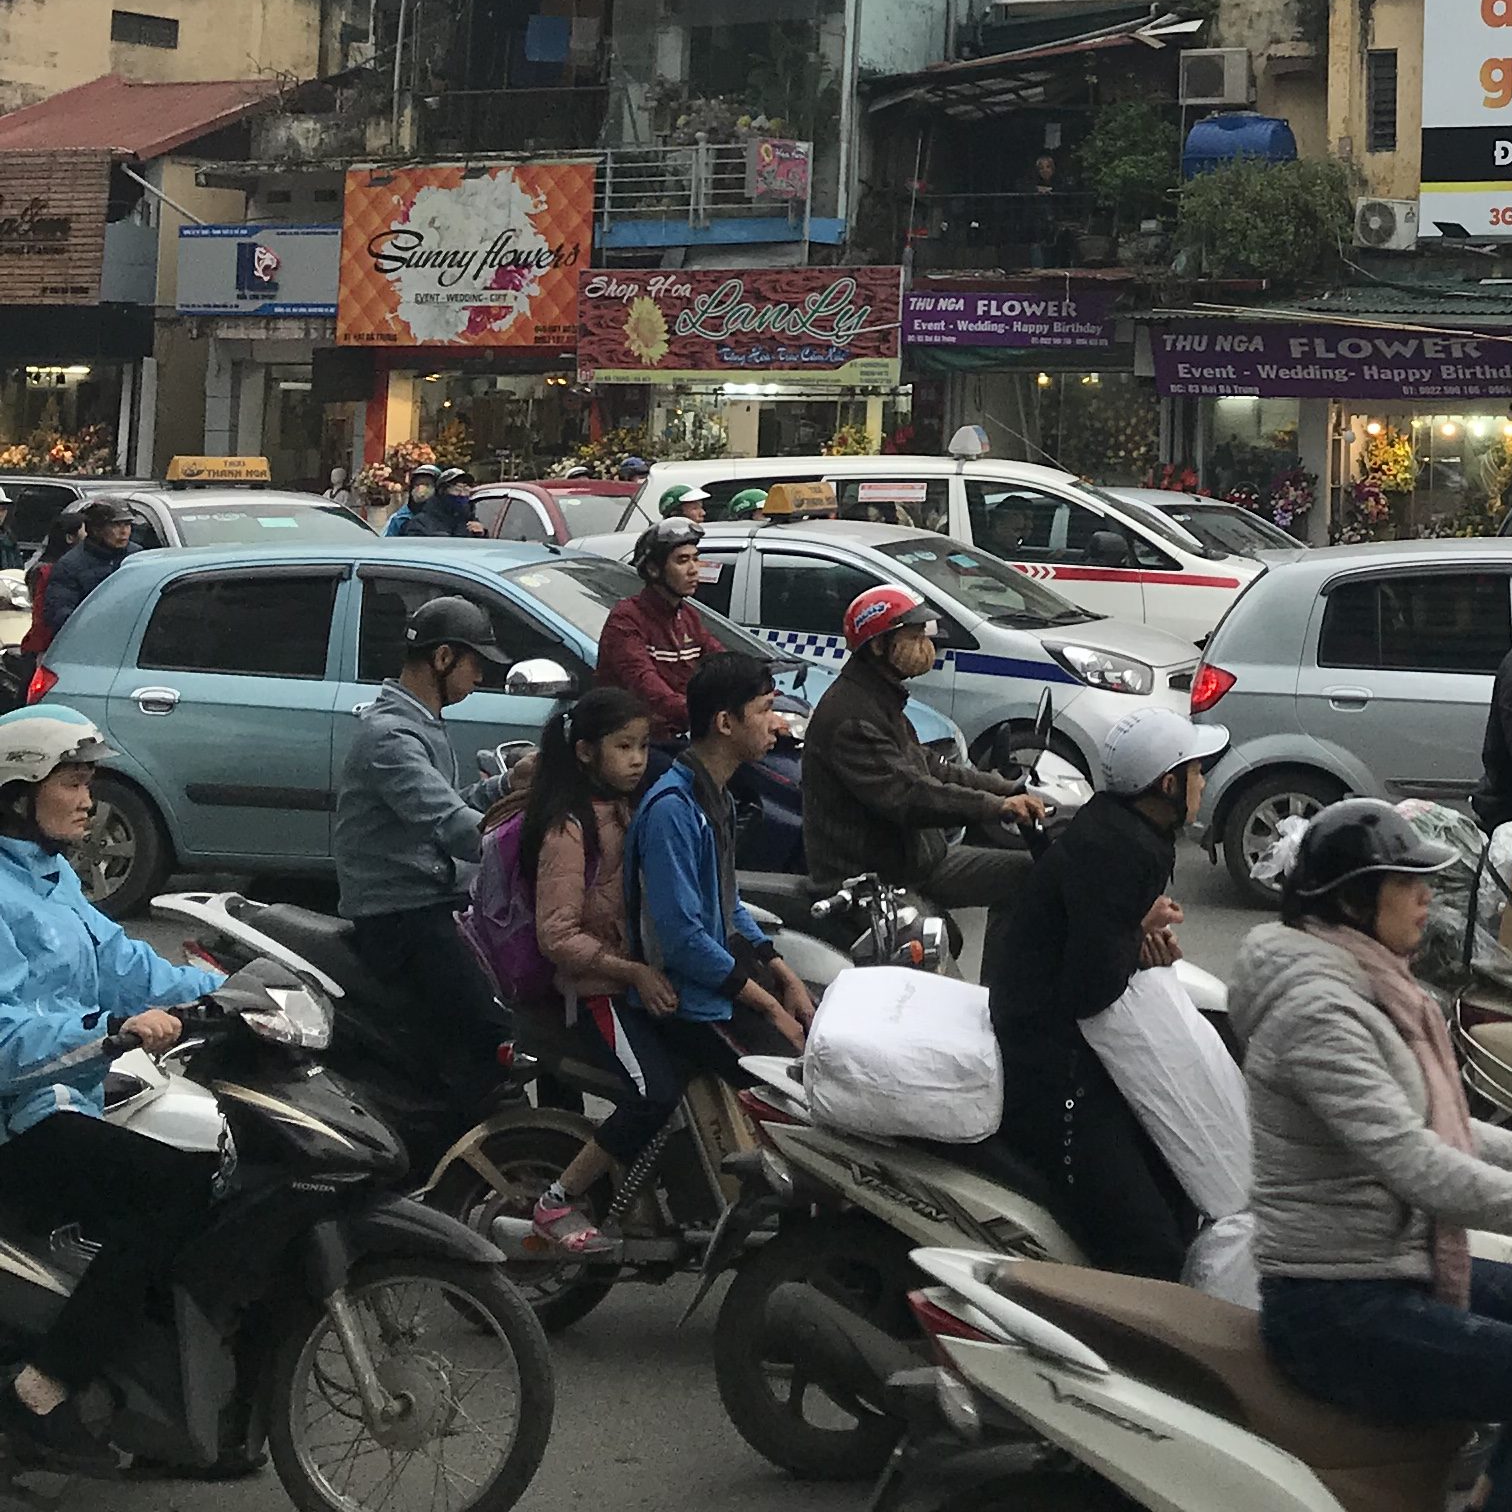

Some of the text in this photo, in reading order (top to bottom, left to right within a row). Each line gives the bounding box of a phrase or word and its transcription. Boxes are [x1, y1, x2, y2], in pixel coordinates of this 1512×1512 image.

[367, 229, 482, 287] Sunny
[414, 292, 441, 304] EVENT
[584, 275, 692, 303] Shop Hoa
[909, 298, 1078, 318] THU NGA FLOWER
[913, 319, 946, 332] Event
[1013, 321, 1050, 335] Happy
[1053, 322, 1103, 336] Birthday
[1162, 335, 1483, 360] THU NGA FLOWER
[1177, 363, 1237, 379] Event
[1363, 364, 1432, 383] Happy
[206, 469, 242, 479] THANH
[292, 1180, 336, 1193] HONDA
